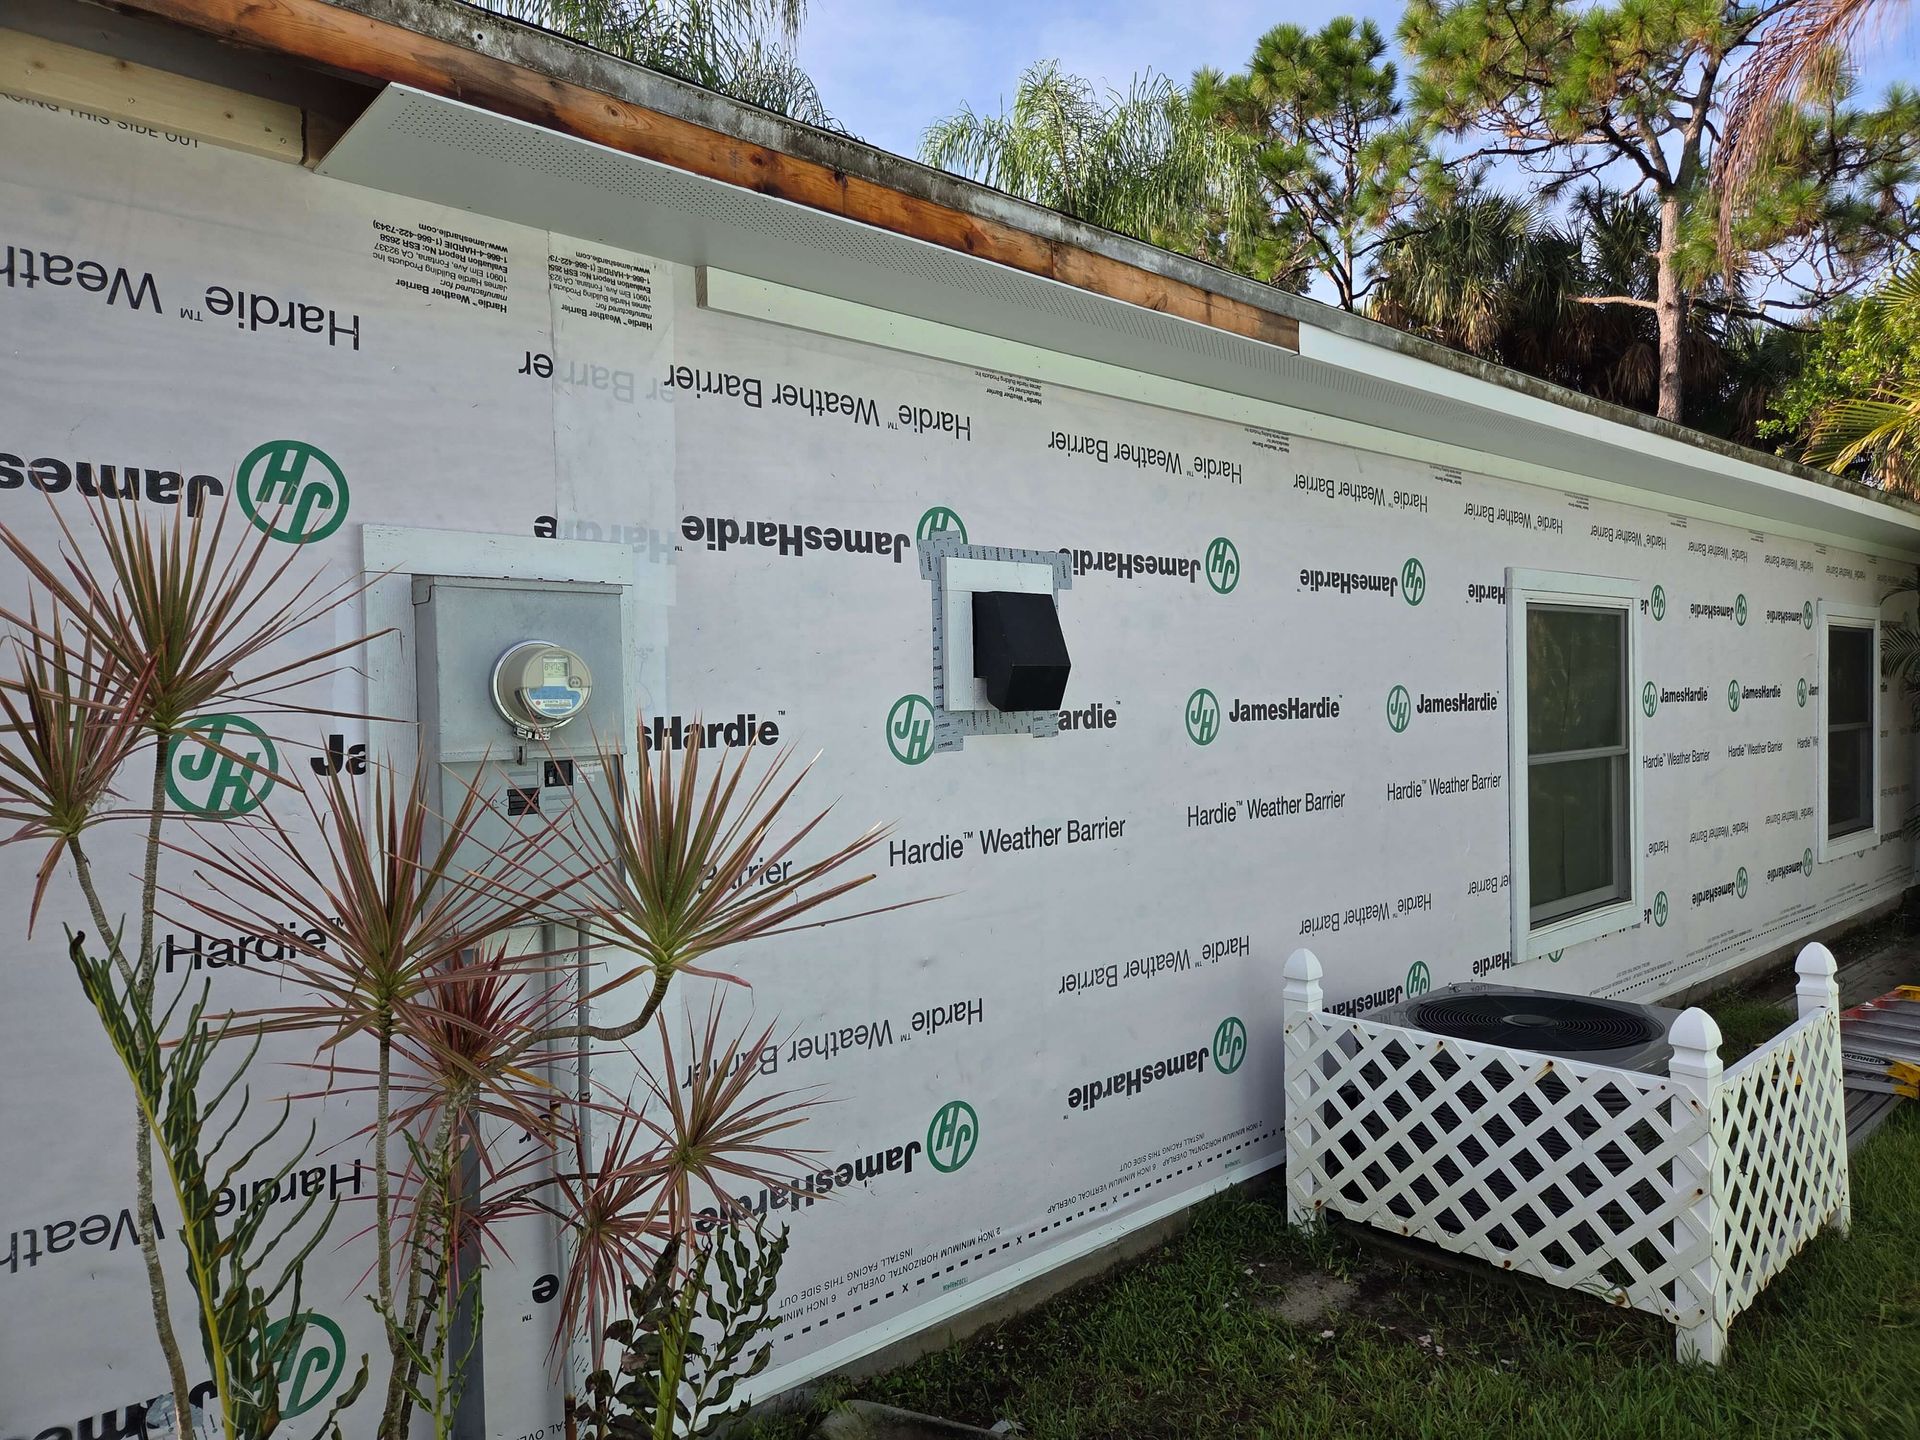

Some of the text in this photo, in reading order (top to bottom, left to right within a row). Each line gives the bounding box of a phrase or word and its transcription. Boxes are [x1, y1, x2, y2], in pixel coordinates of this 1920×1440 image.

[372, 219, 508, 264] 1-866-4-HARDIE (1-866-422-7343)
[374, 242, 400, 255] 92337
[380, 233, 508, 274] Evaluation Report No: ESR 2658
[400, 249, 414, 259] CA
[372, 252, 508, 292] James Hardie Building Products Inc
[469, 267, 483, 276] Elm
[486, 274, 507, 283] 10901
[563, 268, 578, 277] ESR
[564, 276, 574, 285] CA
[580, 271, 592, 280] No:
[592, 274, 616, 285] Report
[597, 265, 651, 284] 1-866-4-HARDIE
[395, 279, 429, 294] Barrier
[431, 287, 470, 304] Weather
[440, 279, 508, 301] manufactured for:
[553, 283, 582, 297] Products
[583, 289, 609, 303] Building
[617, 280, 651, 294] Evaluation
[561, 303, 588, 317] Barrier
[610, 297, 630, 307] Hardie
[631, 301, 652, 312] James
[589, 310, 622, 324] Weather
[608, 305, 653, 319] manufactured
[664, 365, 761, 408] Barrier
[771, 383, 880, 427] Weather
[1048, 431, 1108, 463] Barrier
[1113, 443, 1182, 475] Weather
[1293, 473, 1335, 499] Barrier
[1338, 482, 1386, 507] Weather
[1464, 502, 1531, 530] Weather Barrier
[1591, 525, 1642, 547] Weather Barrier
[1429, 776, 1469, 796] Weather
[1471, 772, 1502, 791] Barrier
[1247, 795, 1302, 820] Weather
[1305, 789, 1346, 812] Barrier
[980, 825, 1062, 855] Weather
[1067, 816, 1126, 844] Barrier
[1467, 877, 1498, 897] Barrier
[1344, 901, 1390, 927] Weather
[1299, 913, 1340, 937] Barrier
[1123, 948, 1191, 981] Weather
[1059, 965, 1117, 995] Barrier
[787, 1019, 894, 1063] Weather
[1843, 1053, 1882, 1064] WERNER
[1133, 1154, 1146, 1166] SIDE
[1147, 1149, 1160, 1160] THIS
[1119, 1161, 1132, 1172] OUT
[1078, 1185, 1108, 1201] VERTICAL
[1047, 1195, 1077, 1214] OVERLAP
[977, 1231, 996, 1243] INCH
[940, 1239, 976, 1259] MINIMUM
[889, 1253, 939, 1279] HORIZONTAL
[779, 1246, 913, 1309] INSTALL FACING THIS SIDE OUT
[847, 1274, 886, 1296] OVERLAP
[806, 1297, 829, 1312] INCH
